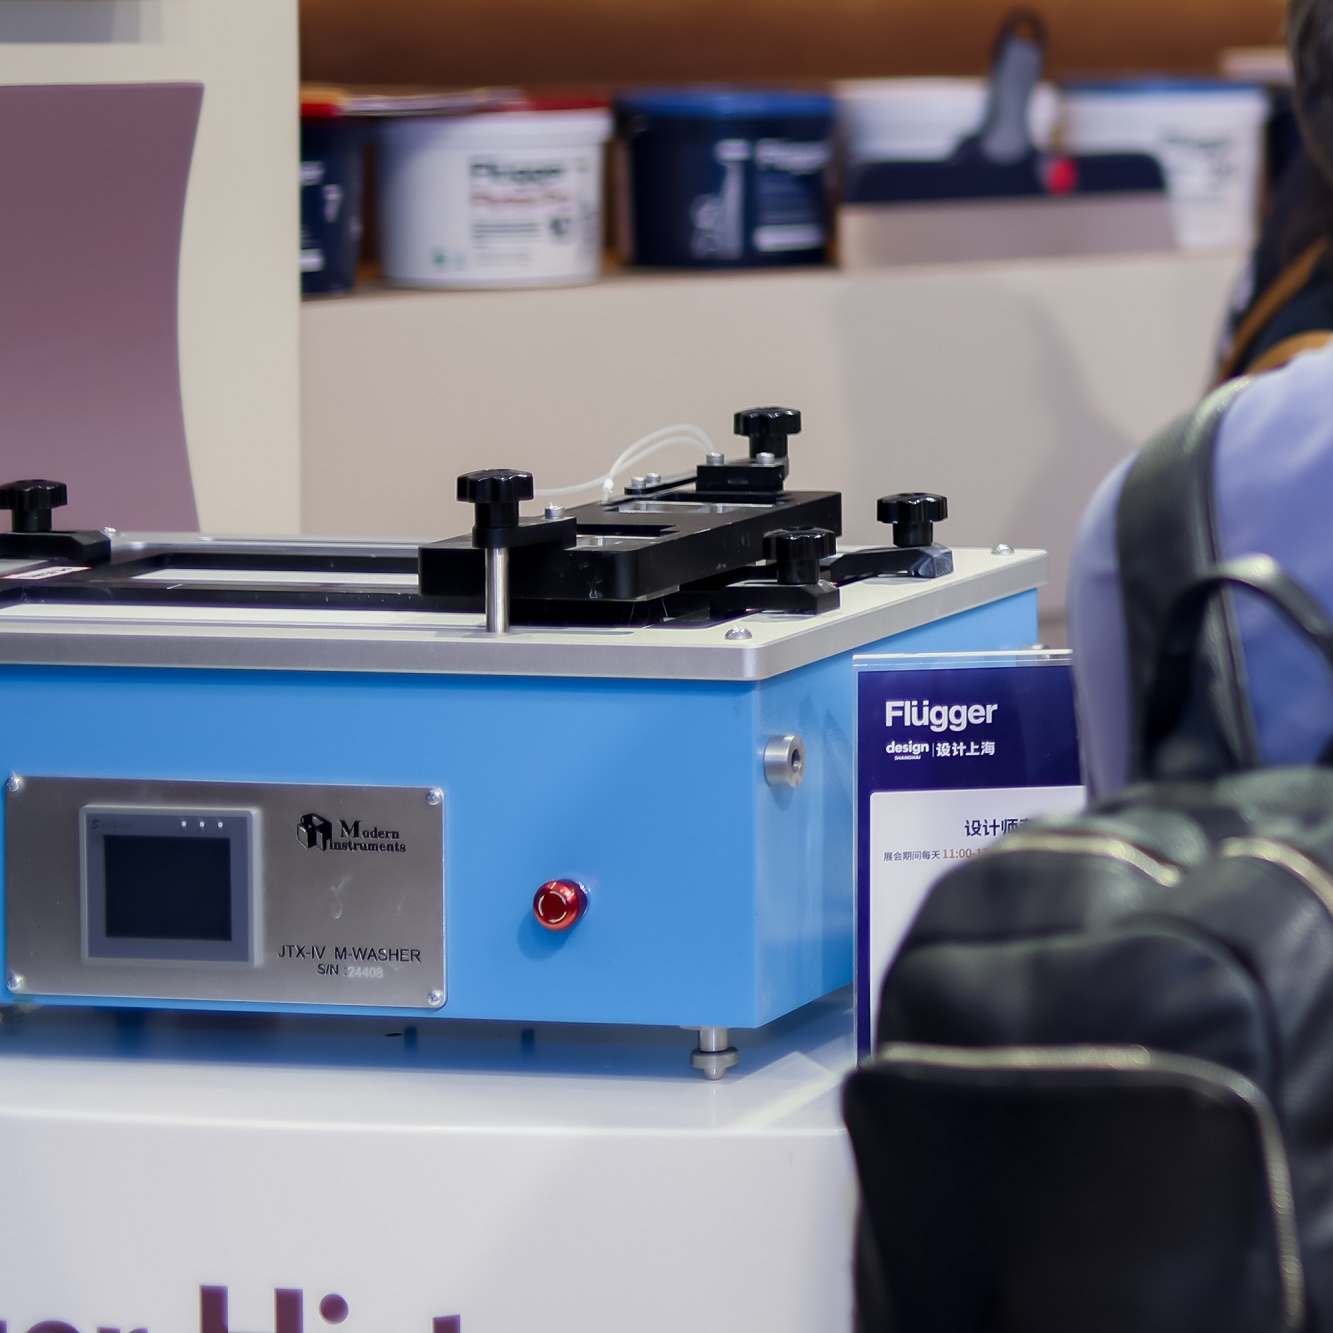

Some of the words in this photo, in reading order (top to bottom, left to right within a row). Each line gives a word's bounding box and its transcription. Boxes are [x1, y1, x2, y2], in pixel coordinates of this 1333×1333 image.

[885, 700, 998, 733] Flügger
[885, 740, 930, 755] design
[936, 741, 996, 757] 设计上海
[339, 819, 400, 839] Modern
[278, 944, 326, 959] JTX-IV
[334, 946, 421, 963] M-WASHER
[317, 963, 338, 976] S/N
